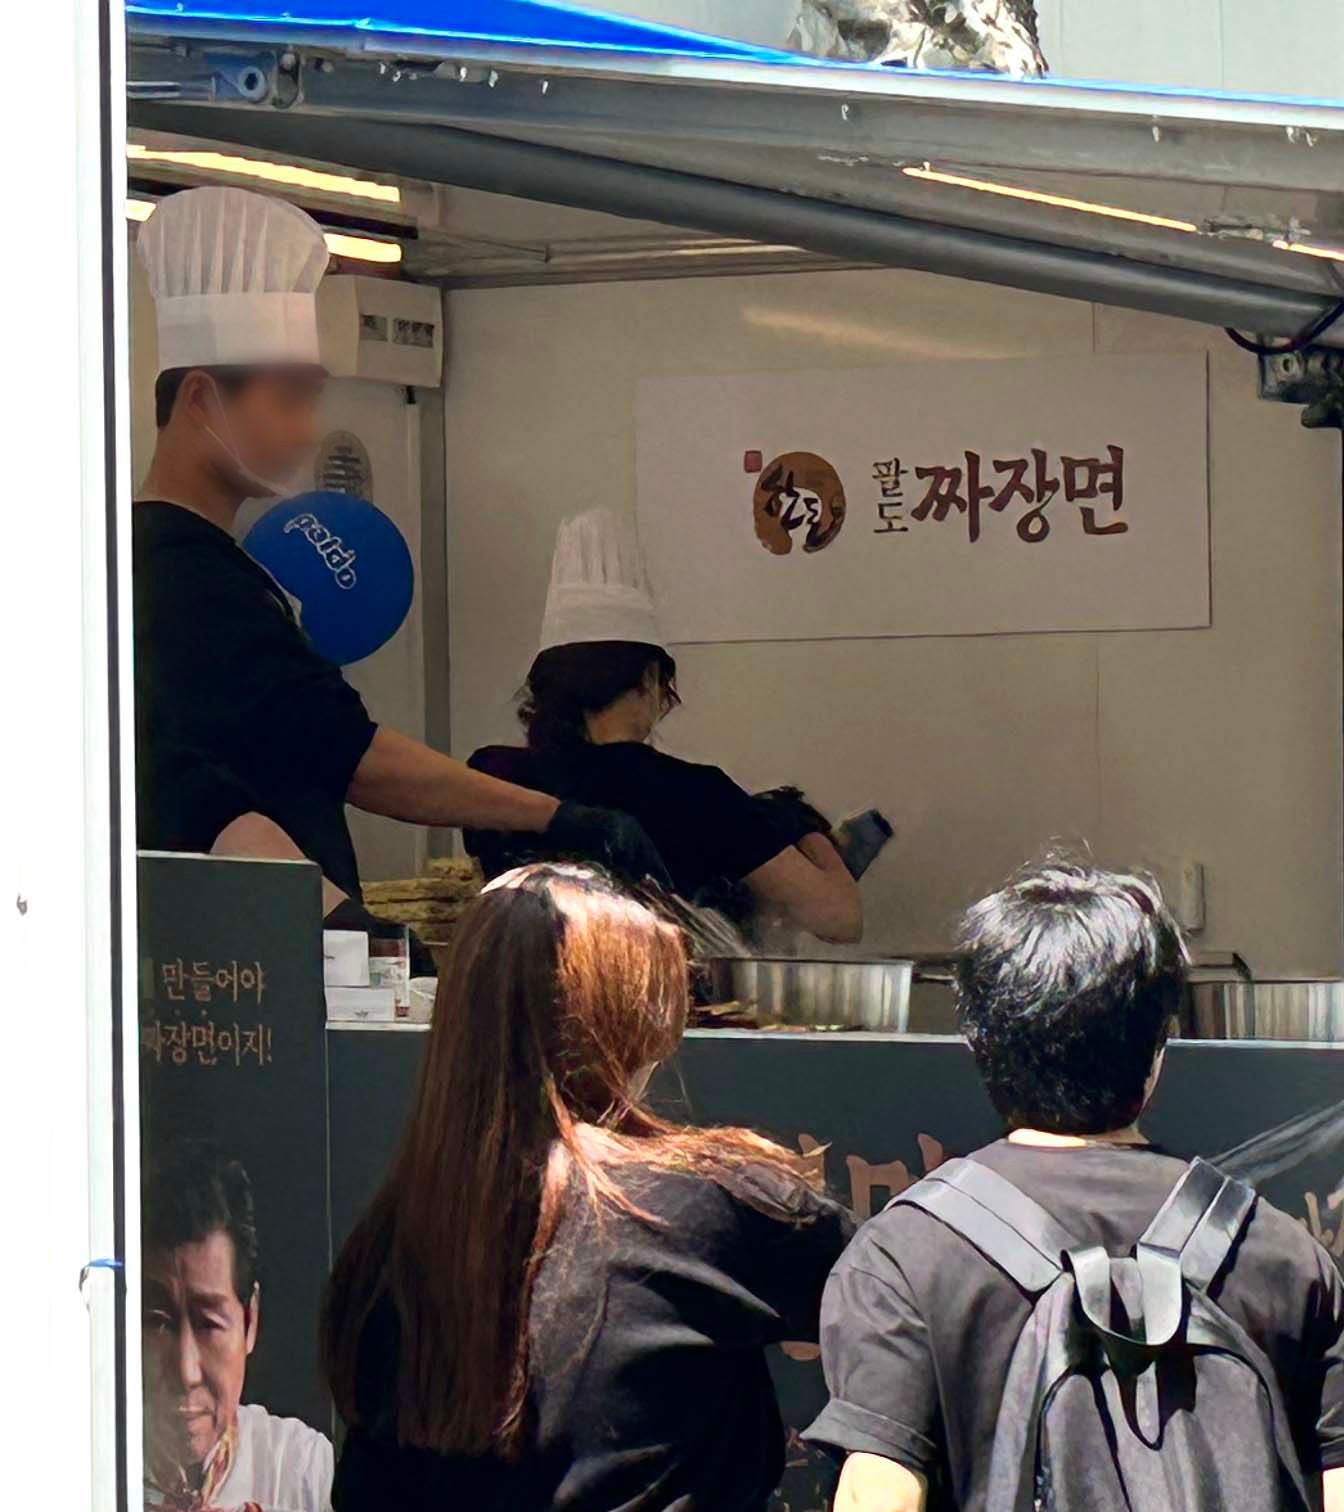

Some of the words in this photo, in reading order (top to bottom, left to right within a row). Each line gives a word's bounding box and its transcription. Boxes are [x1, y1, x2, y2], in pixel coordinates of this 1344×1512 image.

[871, 456, 911, 536] 팔도
[910, 444, 1130, 544] 짜장면
[283, 512, 358, 591] paldo
[160, 956, 267, 1005] 만들어야
